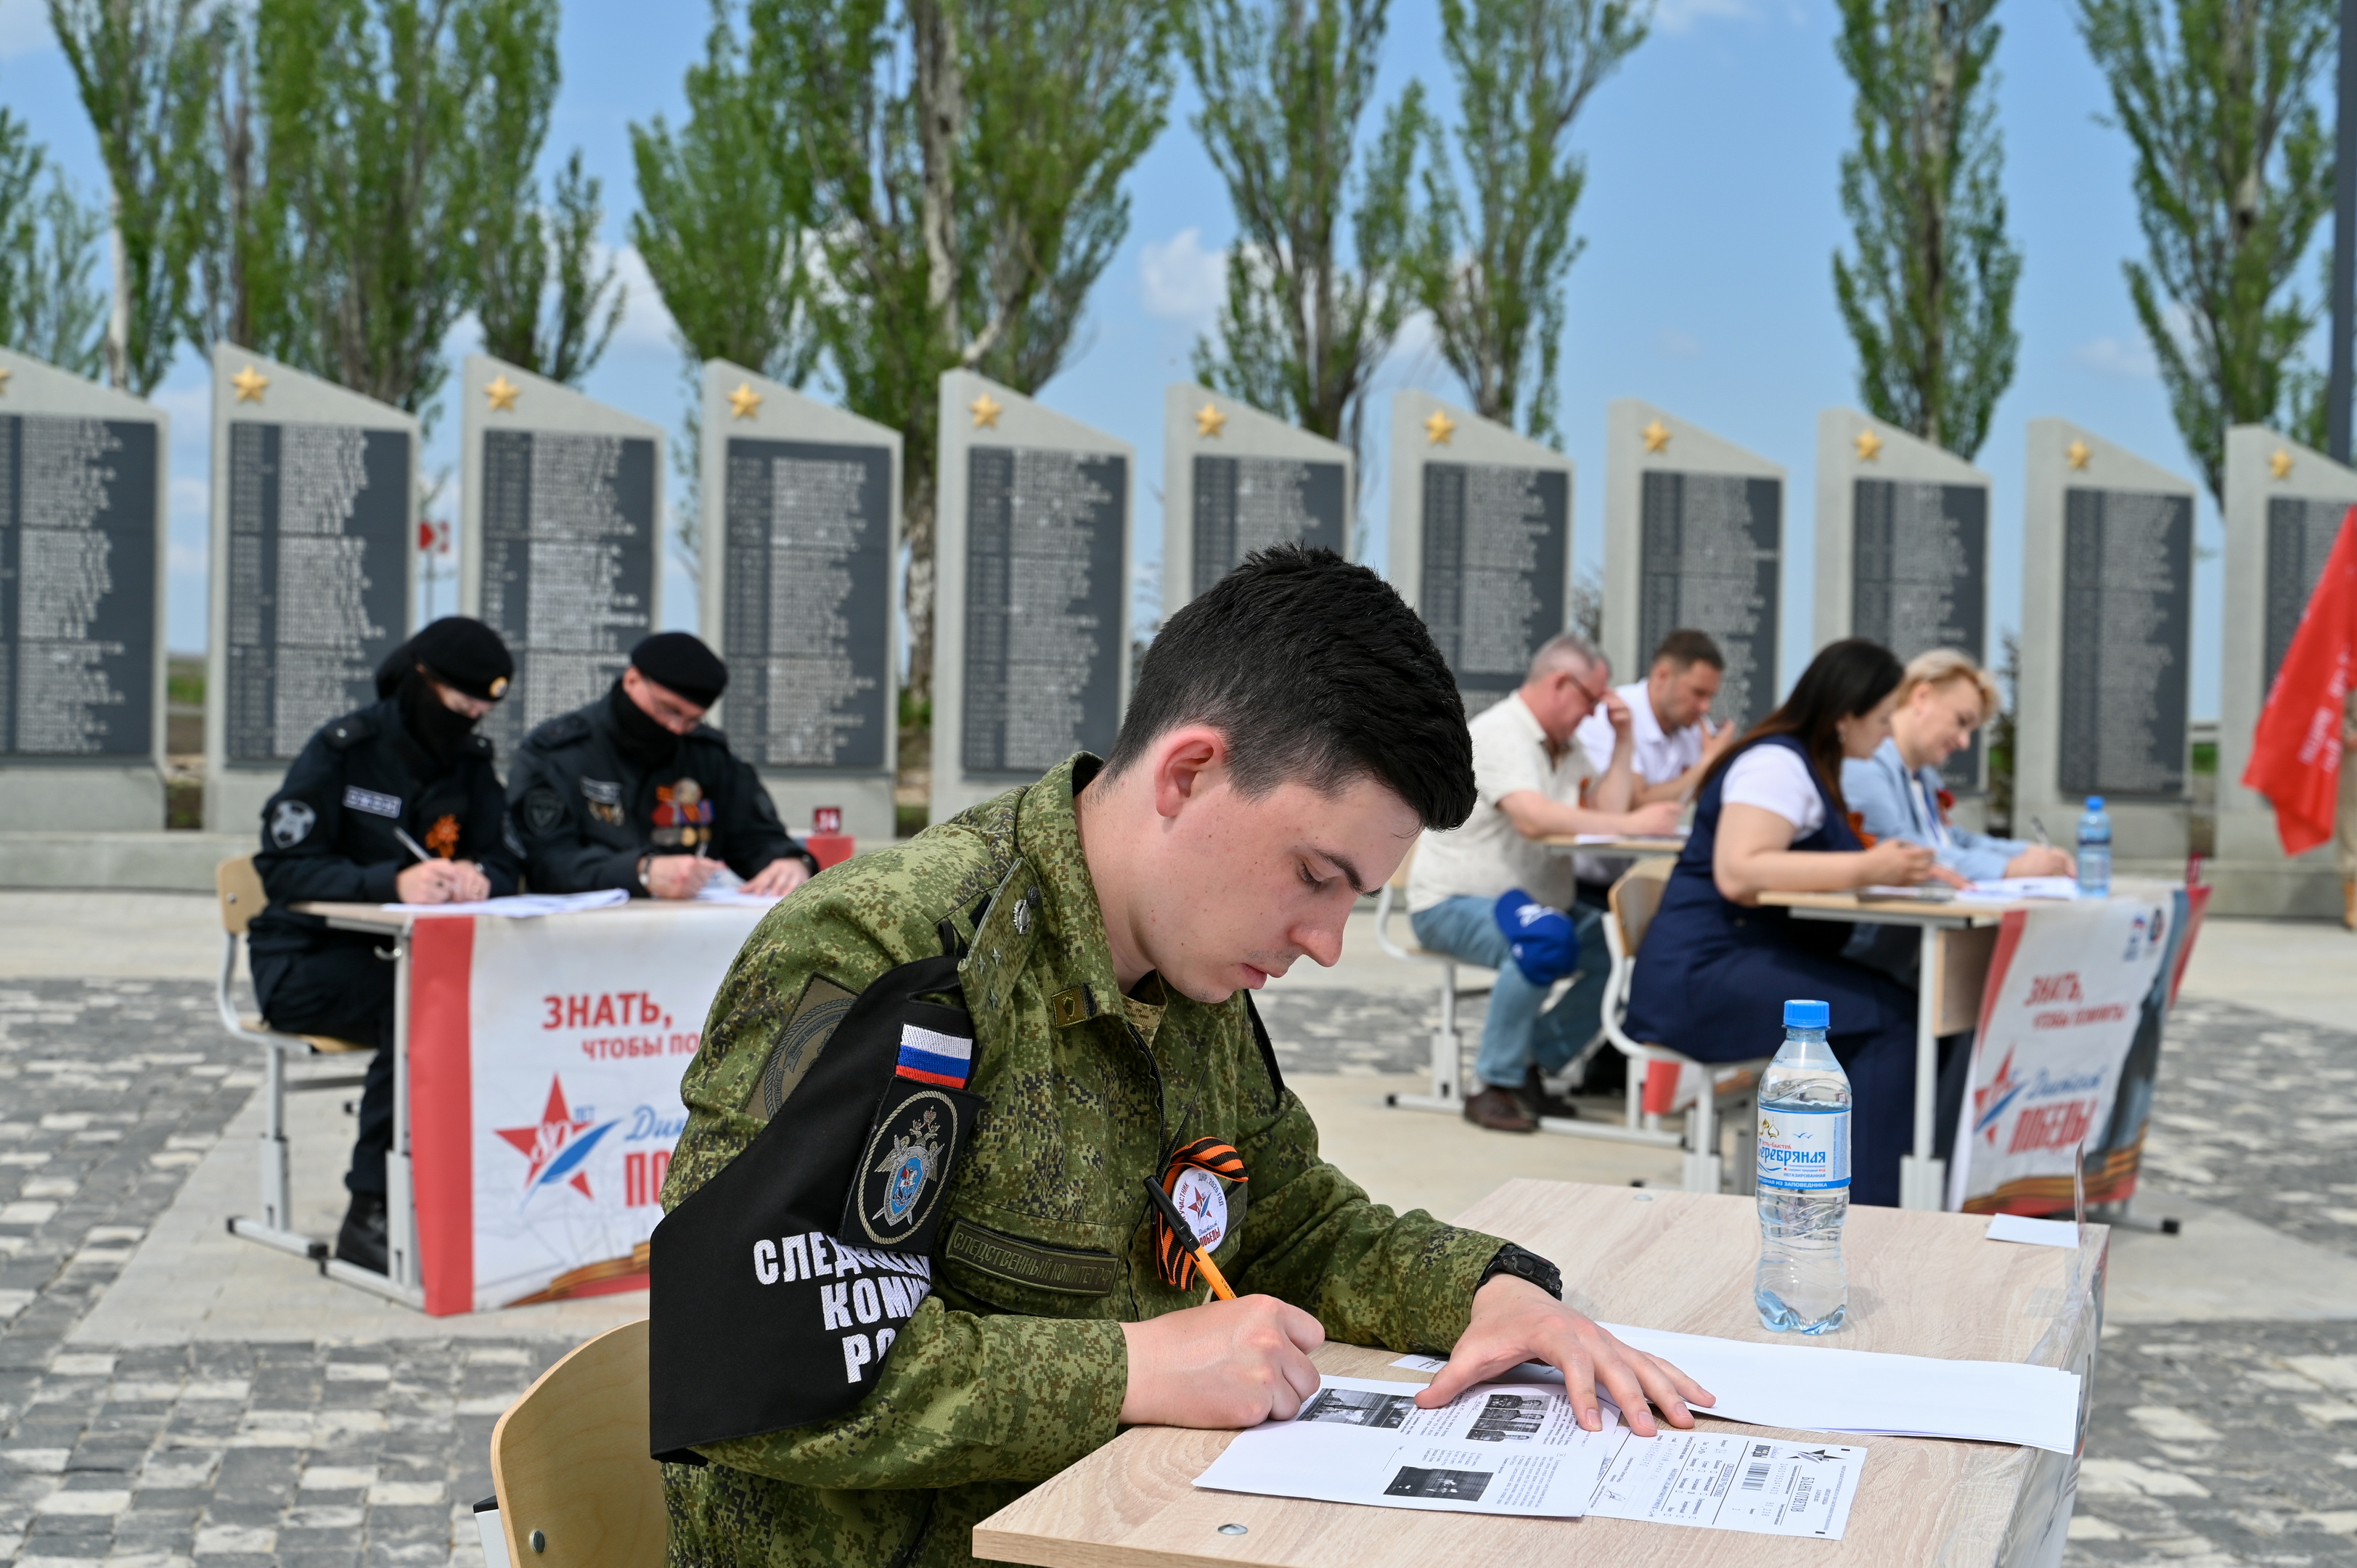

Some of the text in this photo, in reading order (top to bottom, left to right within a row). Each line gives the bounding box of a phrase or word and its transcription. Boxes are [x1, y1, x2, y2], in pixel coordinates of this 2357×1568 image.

[542, 991, 672, 1031] ЗНАТЬ,
[583, 1032, 700, 1061] ЧТОБЫ ПО
[624, 1106, 683, 1142] Дик
[624, 1151, 670, 1208] ПО
[1208, 1177, 1220, 1193] 2025
[1199, 1227, 1221, 1247] ПОБЕДЫ
[953, 1232, 1112, 1286] СЛЕДСТВЕННЫЙ КОМИТЕТ РФ
[841, 1328, 896, 1384] РО
[1791, 1492, 1810, 1512] ОТВЕТОВ
